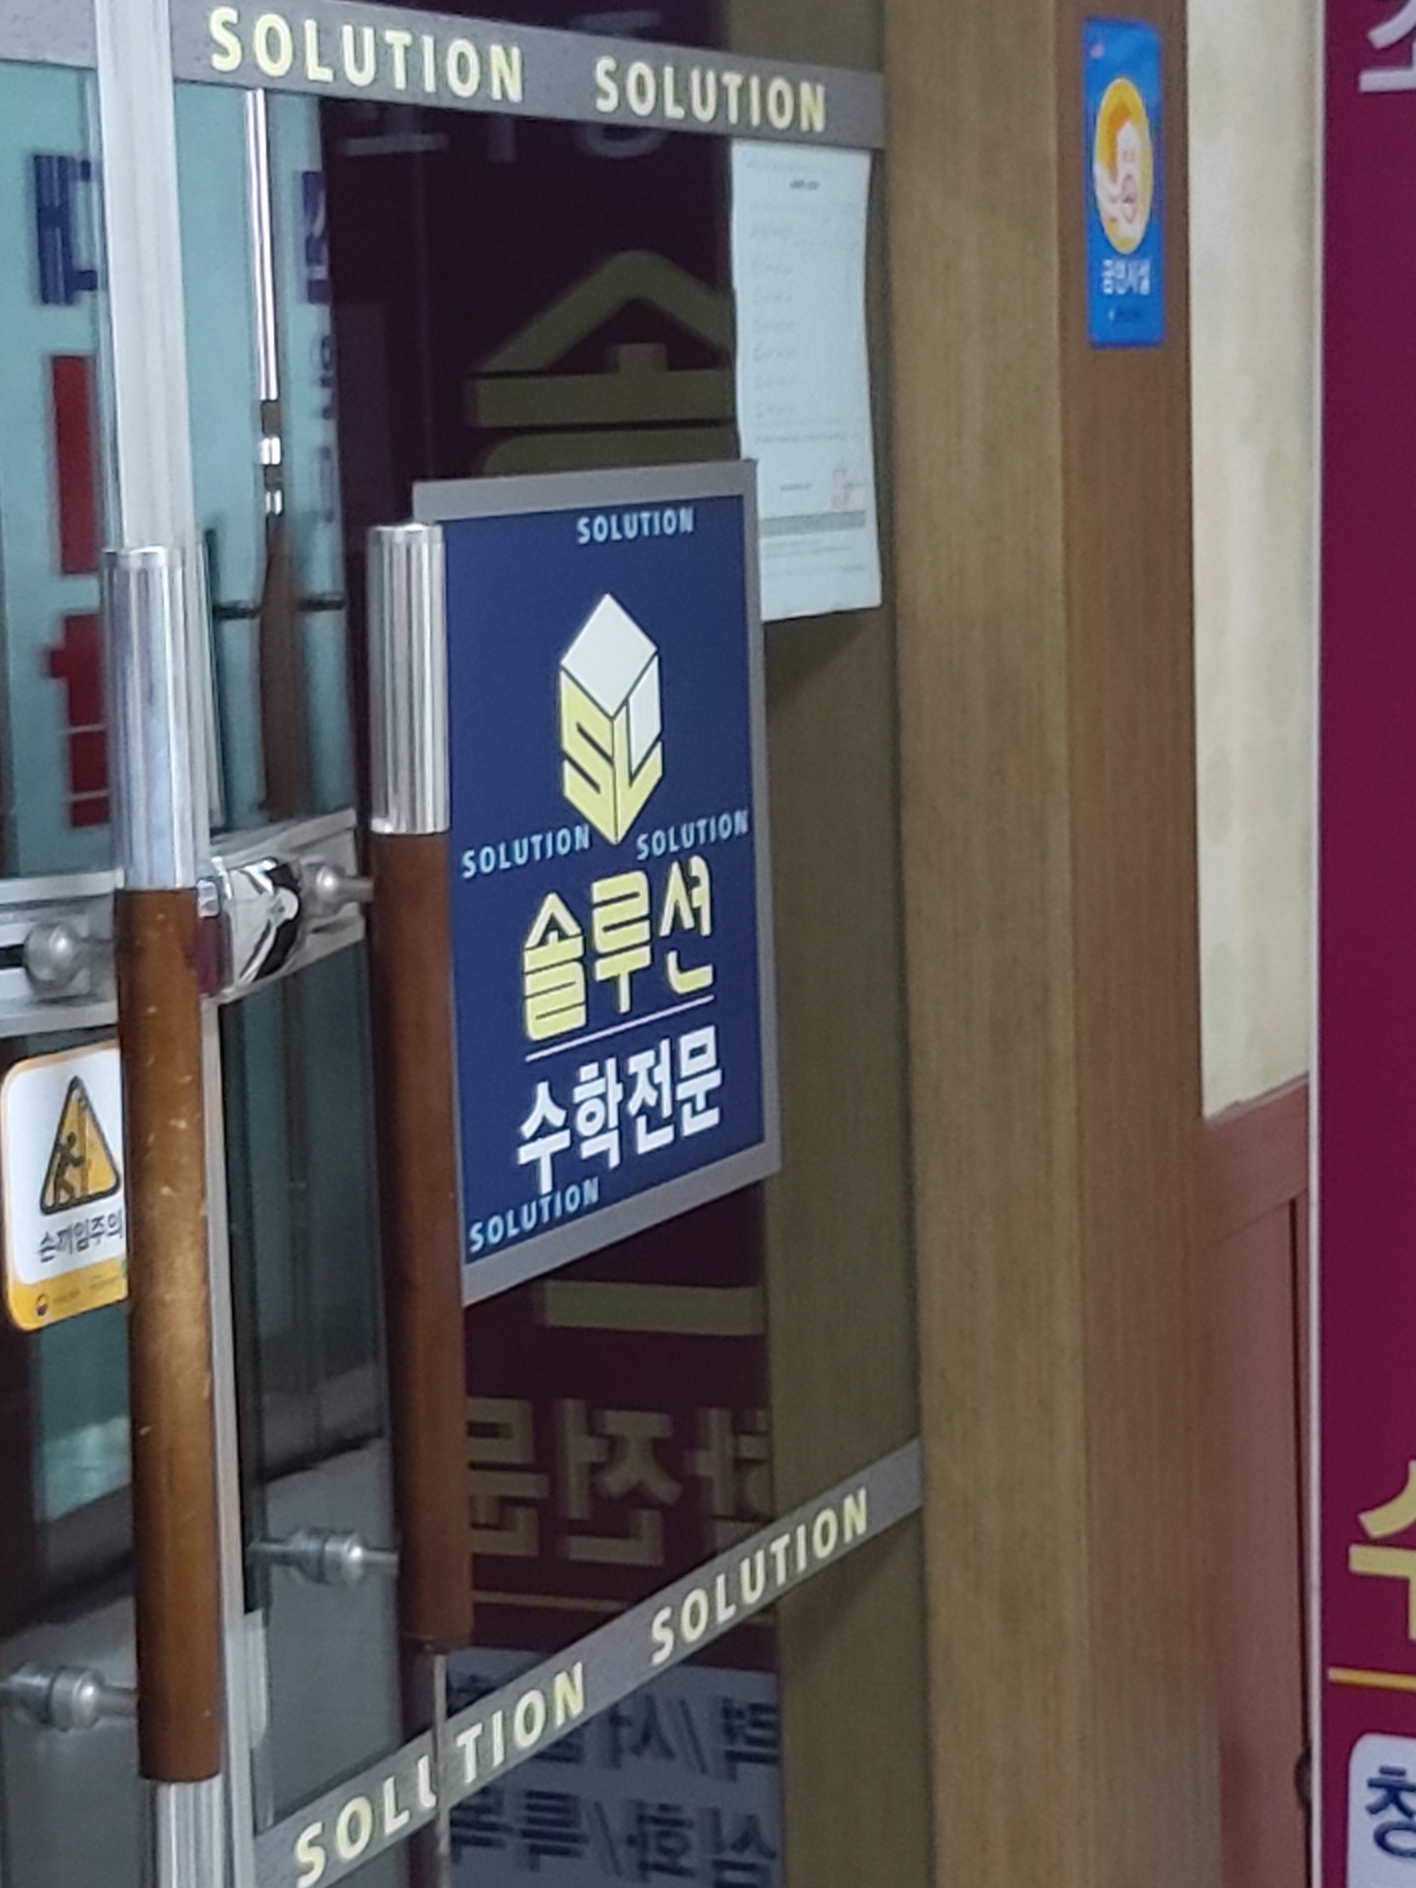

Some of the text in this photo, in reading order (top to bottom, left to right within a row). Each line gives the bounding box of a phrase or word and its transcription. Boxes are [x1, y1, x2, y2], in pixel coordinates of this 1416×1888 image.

[208, 7, 826, 133] SOLUTION SOLUTION
[576, 506, 695, 544] SOLUTION
[461, 810, 750, 879] SOLUTION SOLUTION
[523, 855, 713, 1042] 솔루션
[517, 1025, 722, 1195] 수학전문
[469, 1177, 600, 1253] SOLUTION
[649, 1488, 869, 1667] SOLUTION
